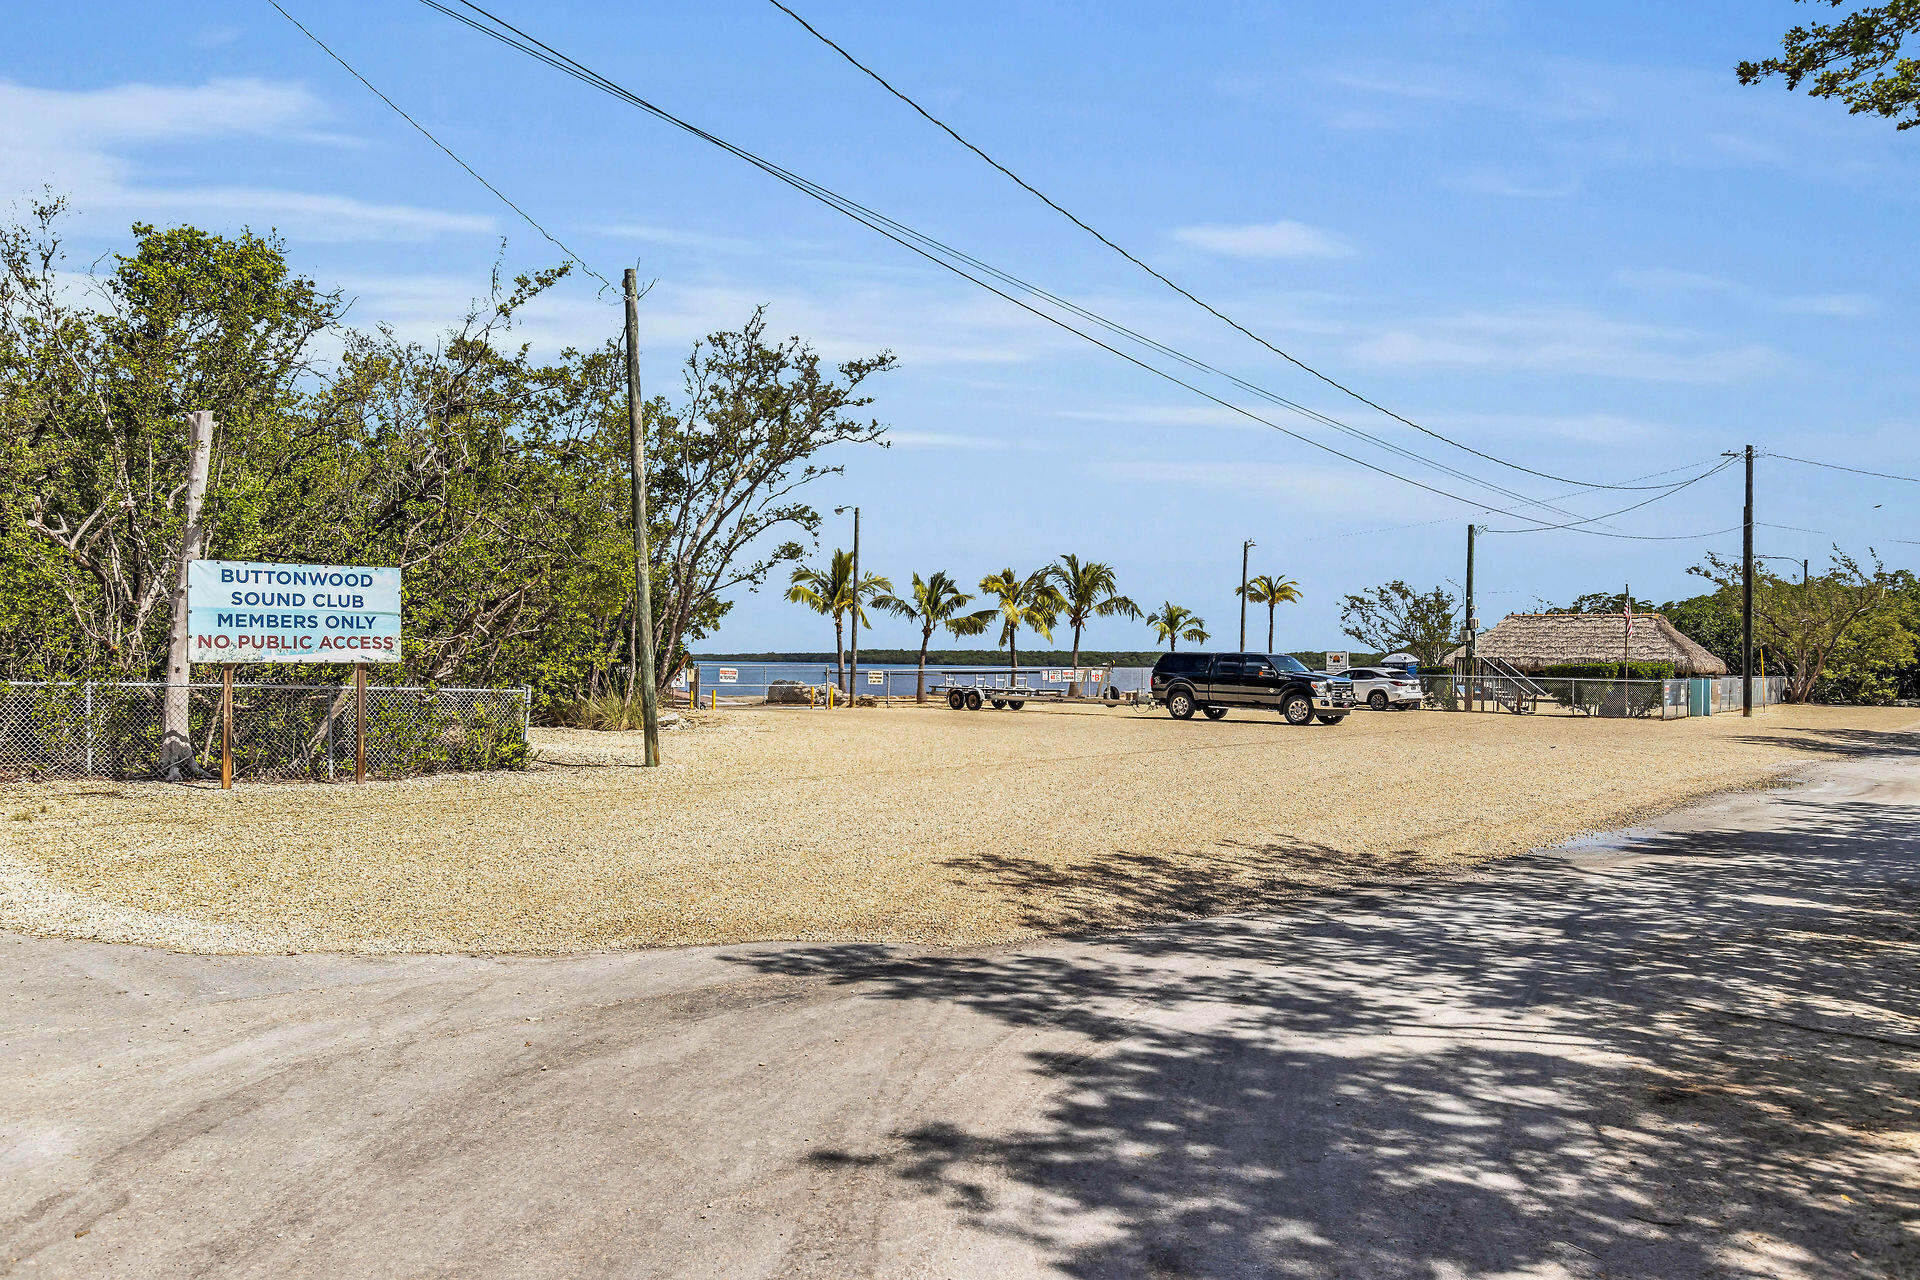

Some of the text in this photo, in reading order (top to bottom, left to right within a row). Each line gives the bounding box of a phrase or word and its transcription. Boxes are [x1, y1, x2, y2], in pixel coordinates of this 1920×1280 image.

[221, 569, 373, 588] BUTTONWOOD
[231, 591, 364, 608] SOUND CLUB
[217, 613, 377, 630] MEMBERS ONLY
[198, 635, 394, 650] NO PUBLIC ACCESS
